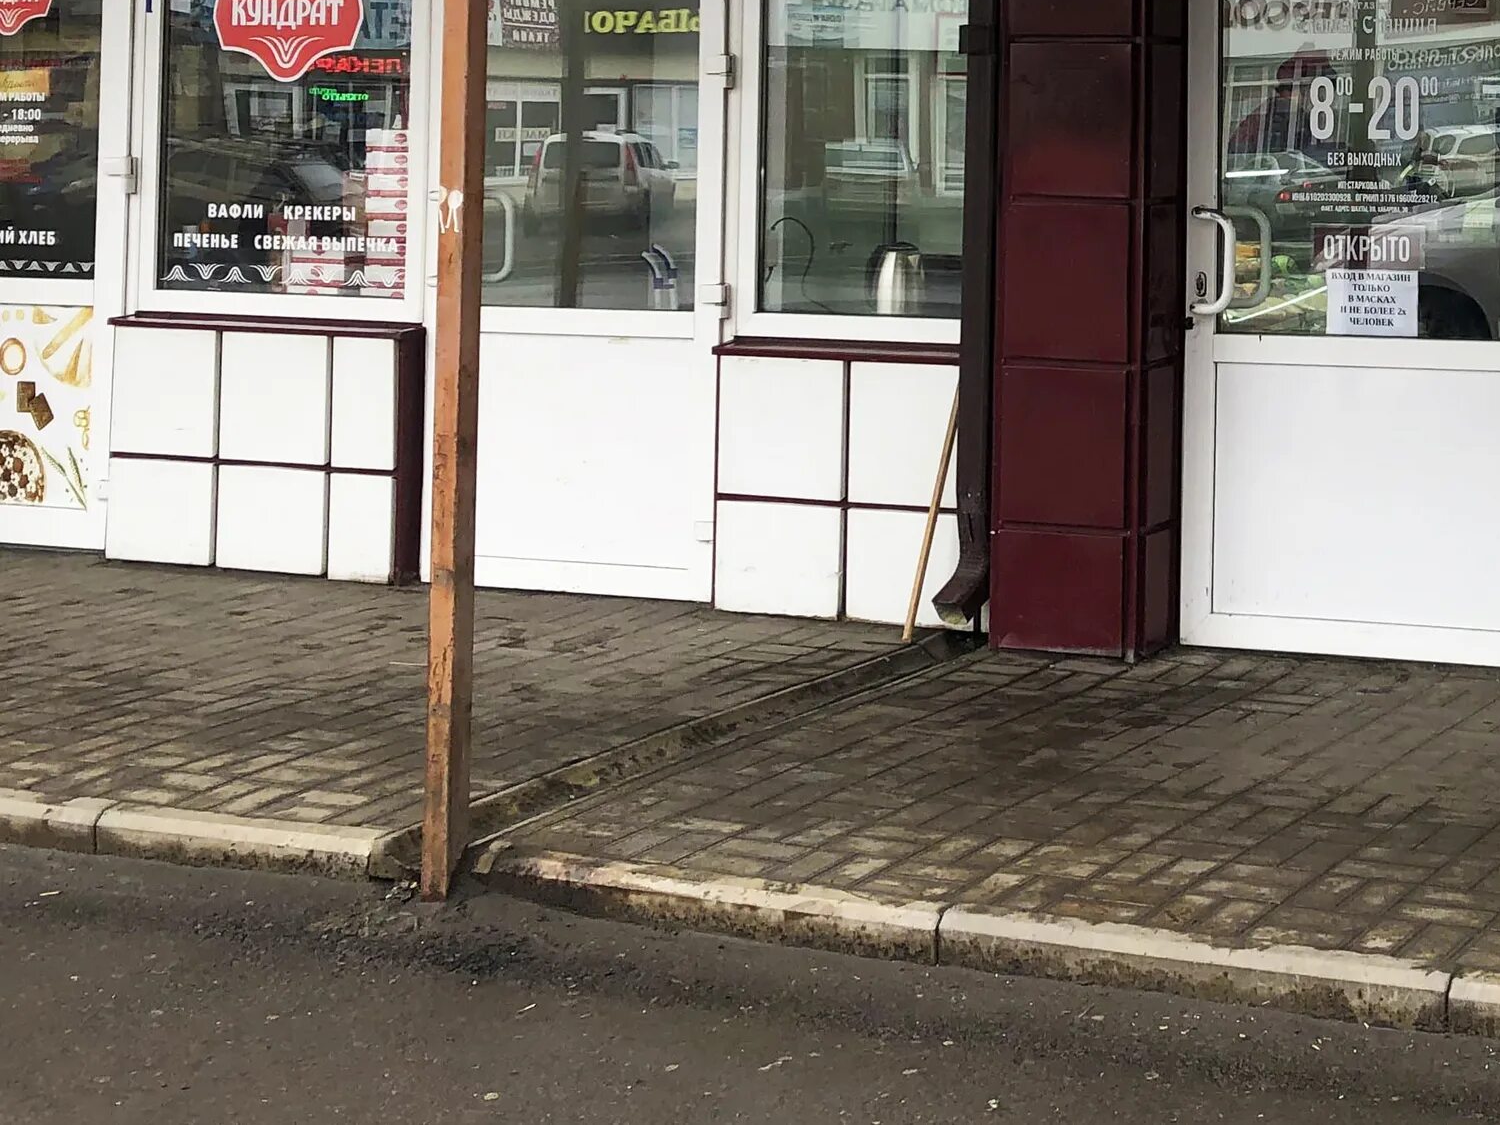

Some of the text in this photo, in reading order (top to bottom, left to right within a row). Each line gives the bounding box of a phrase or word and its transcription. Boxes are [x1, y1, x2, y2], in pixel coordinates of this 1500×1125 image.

[1331, 48, 1363, 60] РЕЖИМ
[11, 108, 42, 121] 18:00
[0, 124, 34, 134] дневно
[1327, 152, 1402, 167] БЕЗ ВЫХОДНЫХ
[207, 203, 356, 222] ВАФЛИ КРЕКЕРЫ
[18, 230, 56, 246] ХЛЕБ
[173, 233, 398, 254] ПЕЧЕНЬЕ СВЕЖАЯ ВЫПЕЧКА
[1323, 235, 1410, 263] ОТКРЫТО
[1331, 272, 1411, 282] ВХОД В МАГАЗИН
[1352, 283, 1391, 292] ТОЛЬКО
[1348, 295, 1396, 304] В МАСКАХ
[1349, 306, 1361, 314] НЕ
[1364, 306, 1396, 315] БОЛЕЕ
[1349, 317, 1394, 327] ЧЕЛОВЕК
